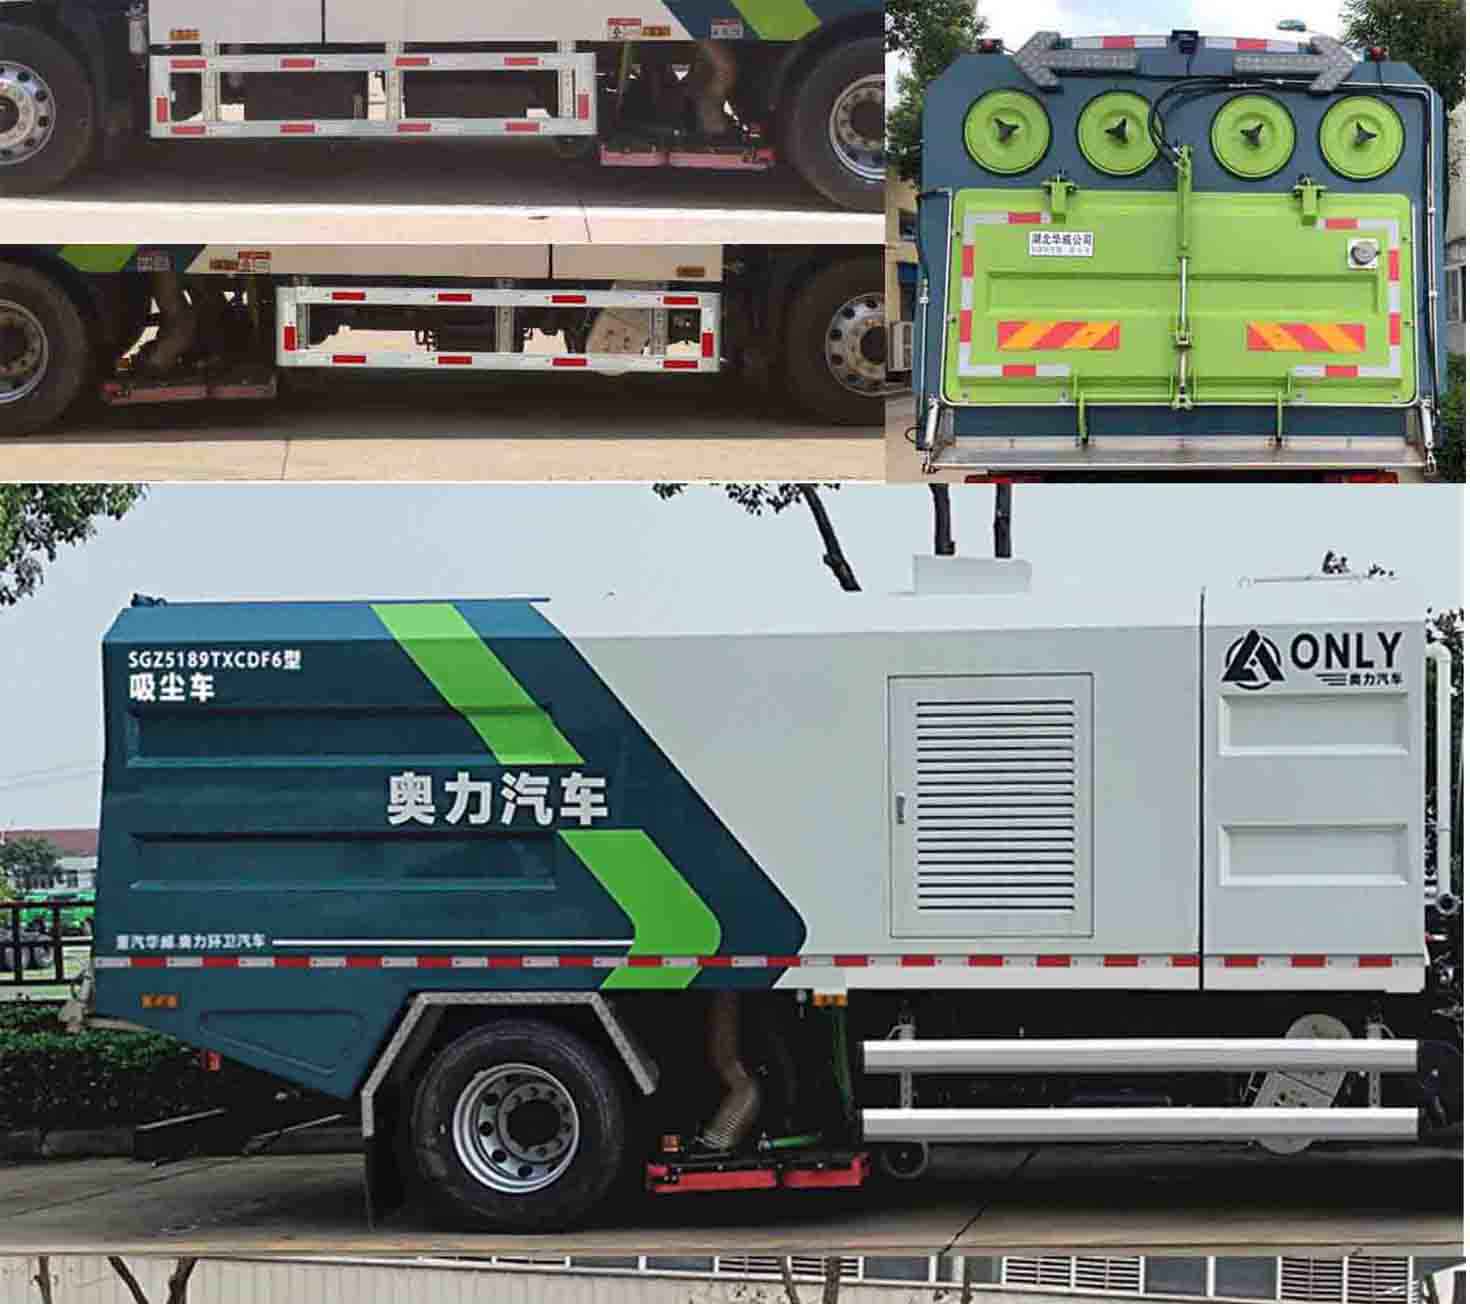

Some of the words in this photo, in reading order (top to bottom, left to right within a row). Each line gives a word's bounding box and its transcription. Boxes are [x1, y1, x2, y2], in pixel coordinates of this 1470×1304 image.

[128, 649, 301, 670] SGZ5189TXCDF6型
[1290, 631, 1402, 670] ONLY
[129, 671, 215, 702] 吸尘车
[1349, 673, 1403, 687] 奥力汽车
[387, 771, 608, 826] 奥力汽车
